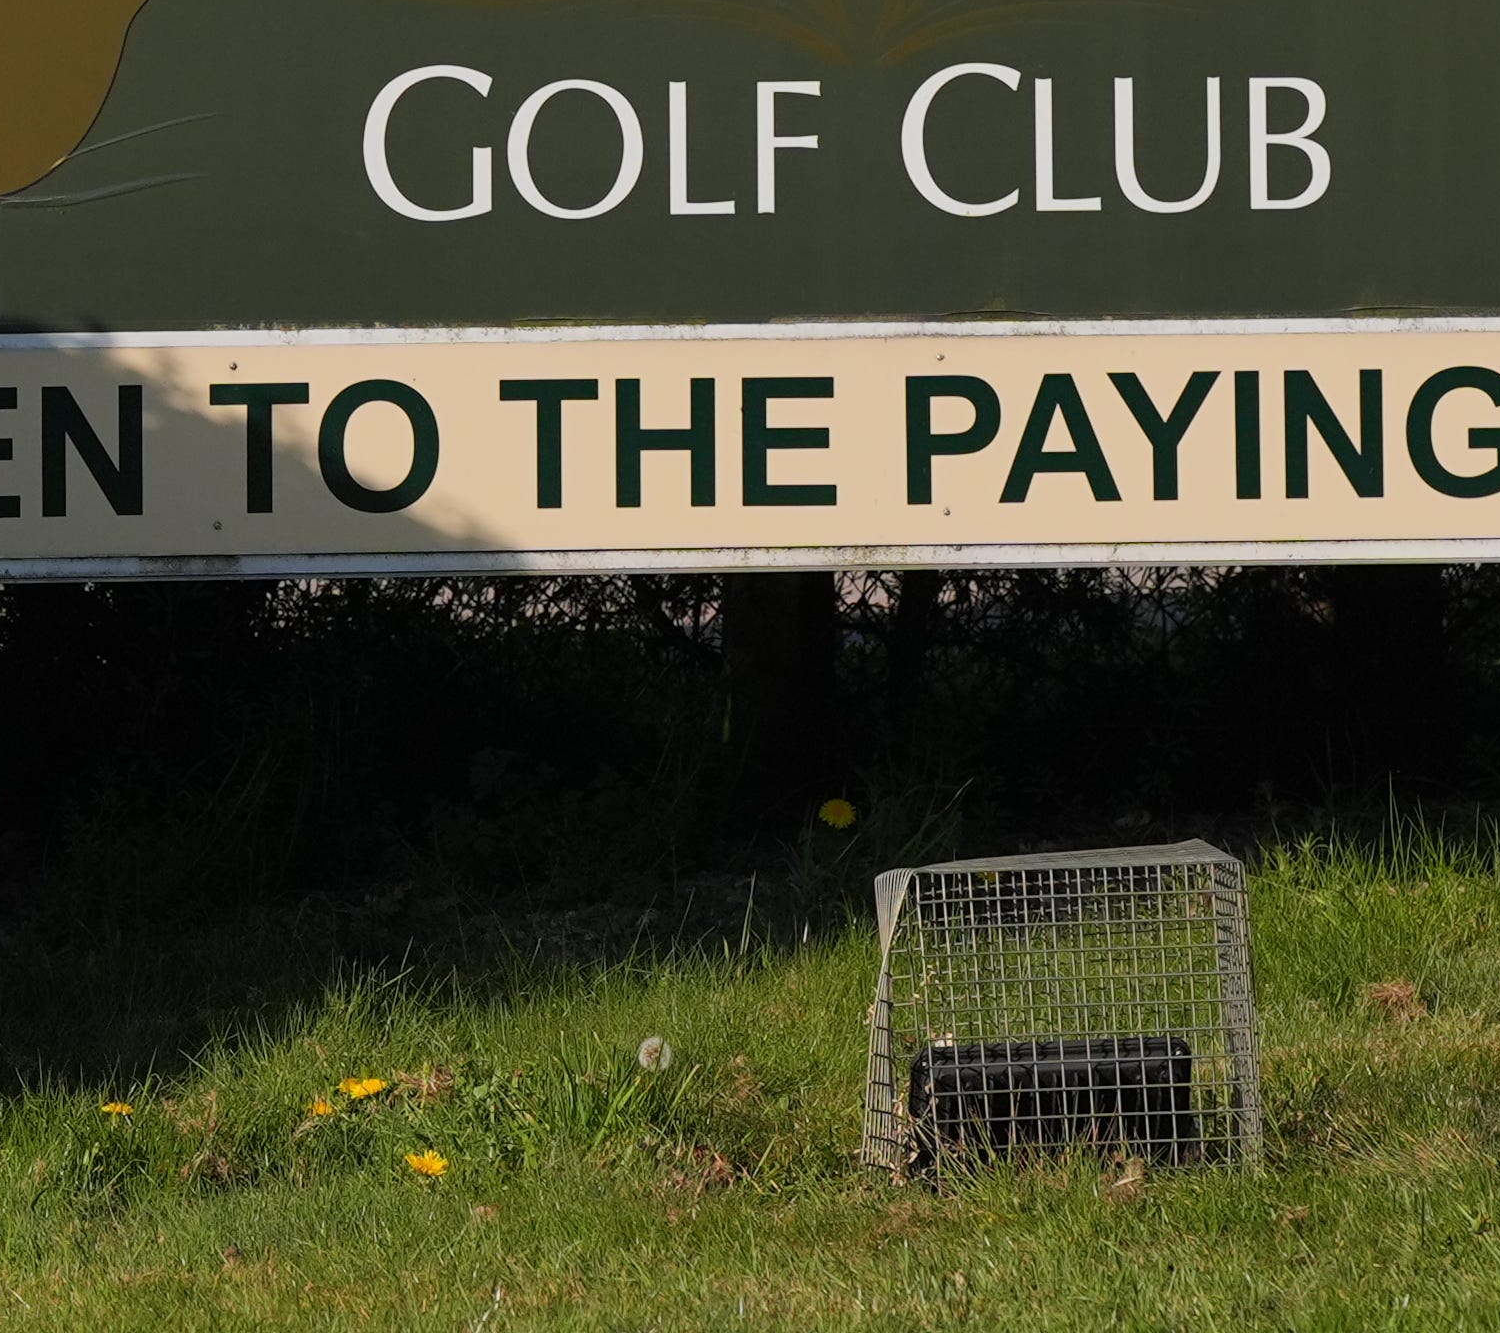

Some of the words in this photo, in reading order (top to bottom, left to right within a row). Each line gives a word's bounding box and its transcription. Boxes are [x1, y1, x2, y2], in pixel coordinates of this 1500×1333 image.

[363, 65, 820, 221] GOLF
[902, 63, 1330, 216] CLUB
[210, 380, 439, 513] TO
[500, 377, 836, 508] THE
